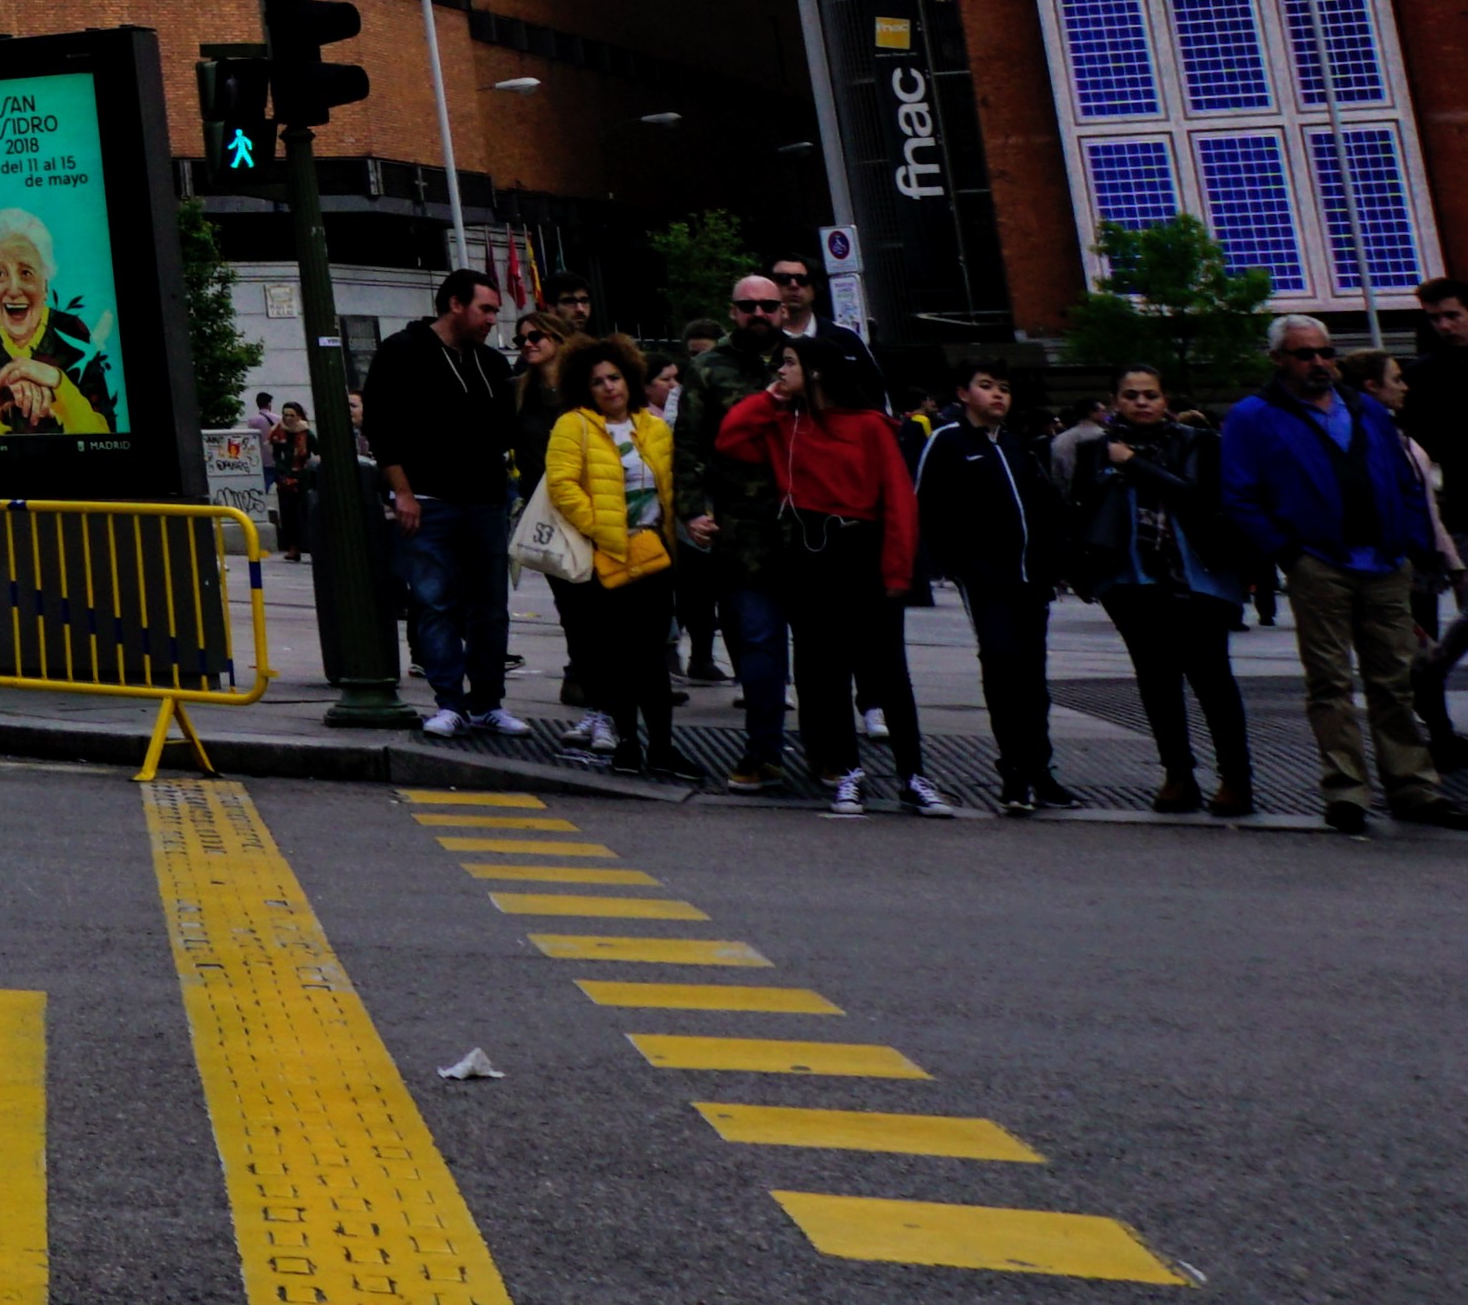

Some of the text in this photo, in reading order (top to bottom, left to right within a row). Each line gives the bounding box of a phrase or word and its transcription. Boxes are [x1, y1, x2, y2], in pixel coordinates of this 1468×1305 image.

[892, 67, 945, 200] fnac
[6, 137, 39, 155] 2018
[0, 155, 76, 174] del 11 al 15
[25, 173, 89, 188] de mayo
[89, 440, 132, 451] MADRID
